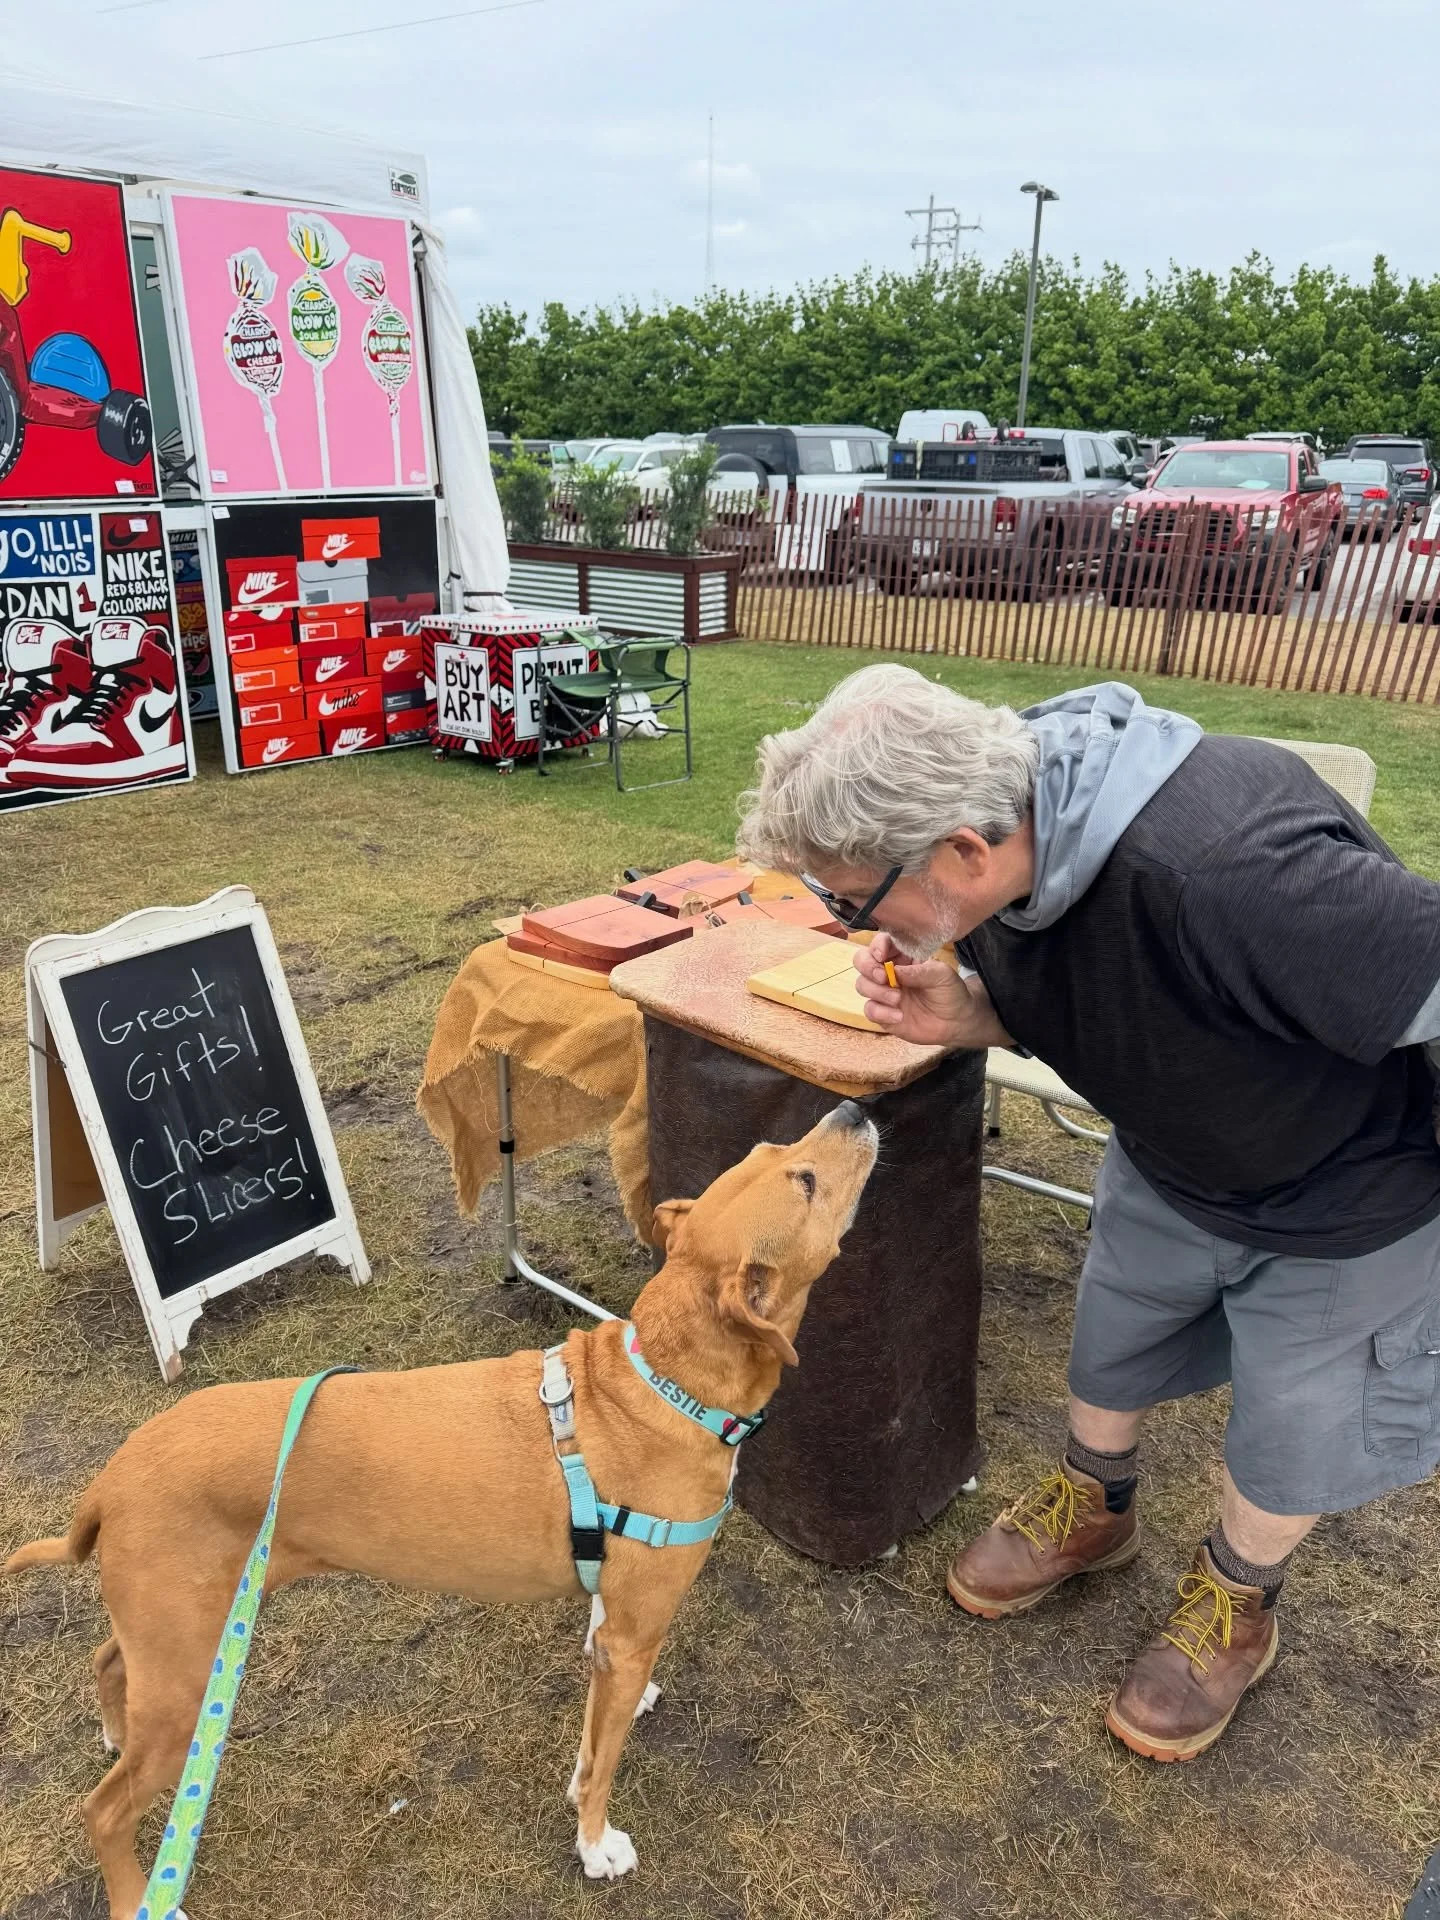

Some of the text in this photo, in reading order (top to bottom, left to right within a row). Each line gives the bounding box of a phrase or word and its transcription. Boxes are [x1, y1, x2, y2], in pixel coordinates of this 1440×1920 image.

[300, 299, 329, 311] CHARMS
[292, 314, 323, 331] BLOW
[233, 340, 265, 360] BLOW
[368, 335, 399, 354] BLOW
[246, 354, 278, 366] CHERRY
[327, 533, 349, 548] NIKE
[40, 551, 92, 575] NOIS
[106, 549, 165, 583] NIKE
[106, 583, 128, 598] RED
[135, 578, 169, 596] BLACK
[245, 571, 278, 591] NIKE
[76, 581, 97, 613] 1
[103, 594, 168, 616] COLORWAY
[320, 655, 344, 669] NIKE
[387, 649, 407, 661] NIKE
[444, 659, 484, 691] BUY
[443, 690, 485, 723] ART
[267, 737, 289, 751] NIKE
[338, 727, 368, 746] NIKE
[97, 967, 218, 1045] Great
[126, 1005, 263, 1102] Gifts!
[129, 1106, 287, 1190] Cheese
[649, 1372, 708, 1422] BESTIE
